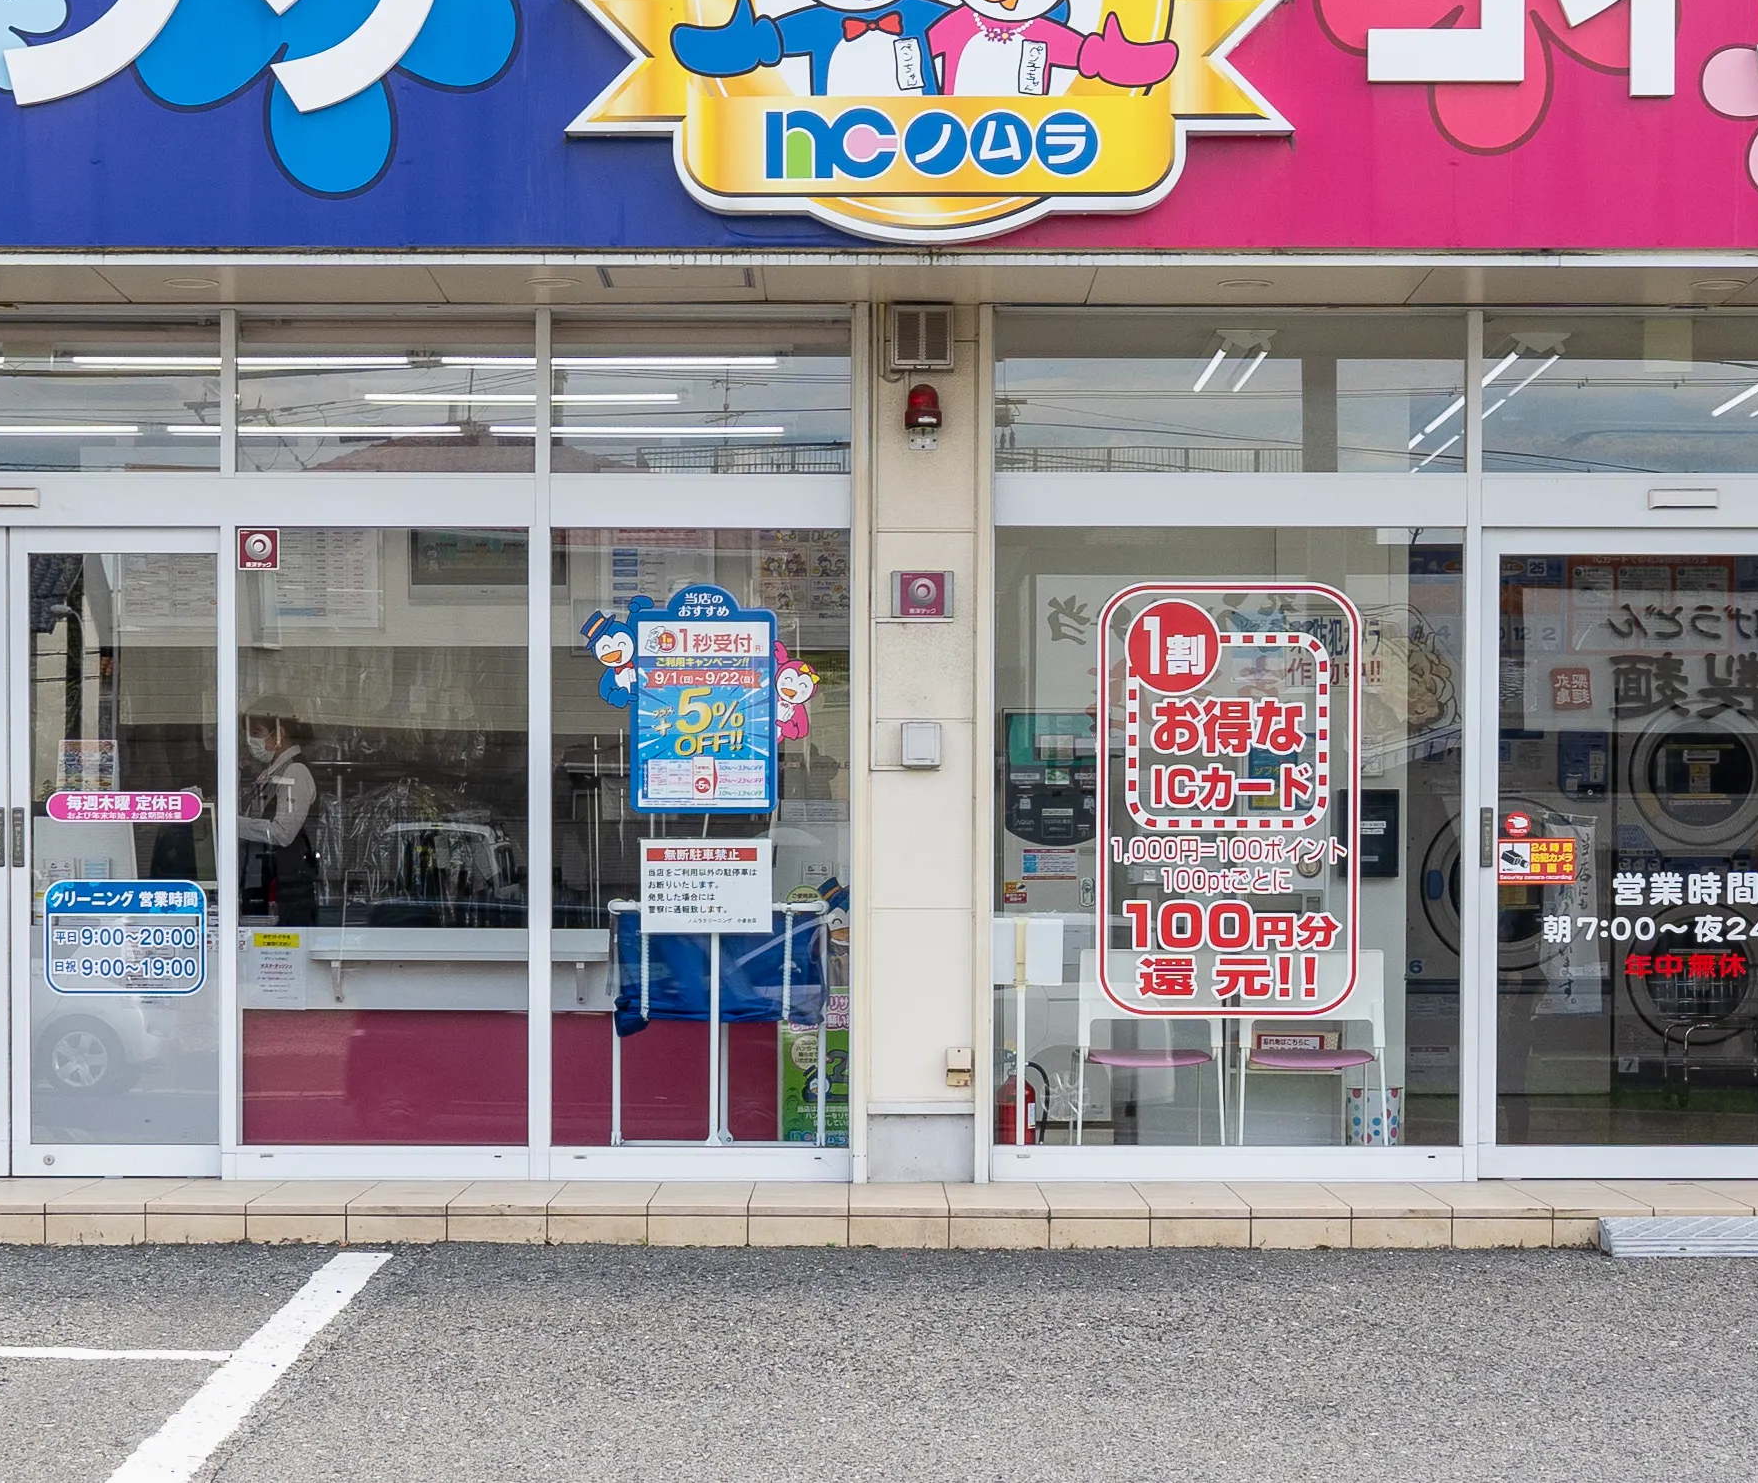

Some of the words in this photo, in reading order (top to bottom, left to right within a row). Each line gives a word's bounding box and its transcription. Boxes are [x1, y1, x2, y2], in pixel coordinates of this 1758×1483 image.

[684, 593, 723, 605] 当店の
[678, 606, 729, 617] おすすめ
[679, 628, 752, 653] 1秒受付
[1143, 615, 1206, 676] 1割
[1154, 701, 1304, 753] お得な
[1154, 767, 1313, 809] ICカード
[67, 795, 130, 811] 毎週木曜
[135, 795, 182, 811] 定休日
[664, 849, 740, 861] 無断駐車禁止
[1531, 853, 1574, 862] 防犯カメラ
[1162, 867, 1292, 895] 100ptごとに
[50, 890, 133, 908] クリーニング
[138, 891, 198, 908] 営業時間
[1122, 902, 1340, 950] 100円分
[55, 931, 77, 943] 平日
[55, 961, 76, 973] 日祝
[1624, 954, 1746, 978] 年中無休
